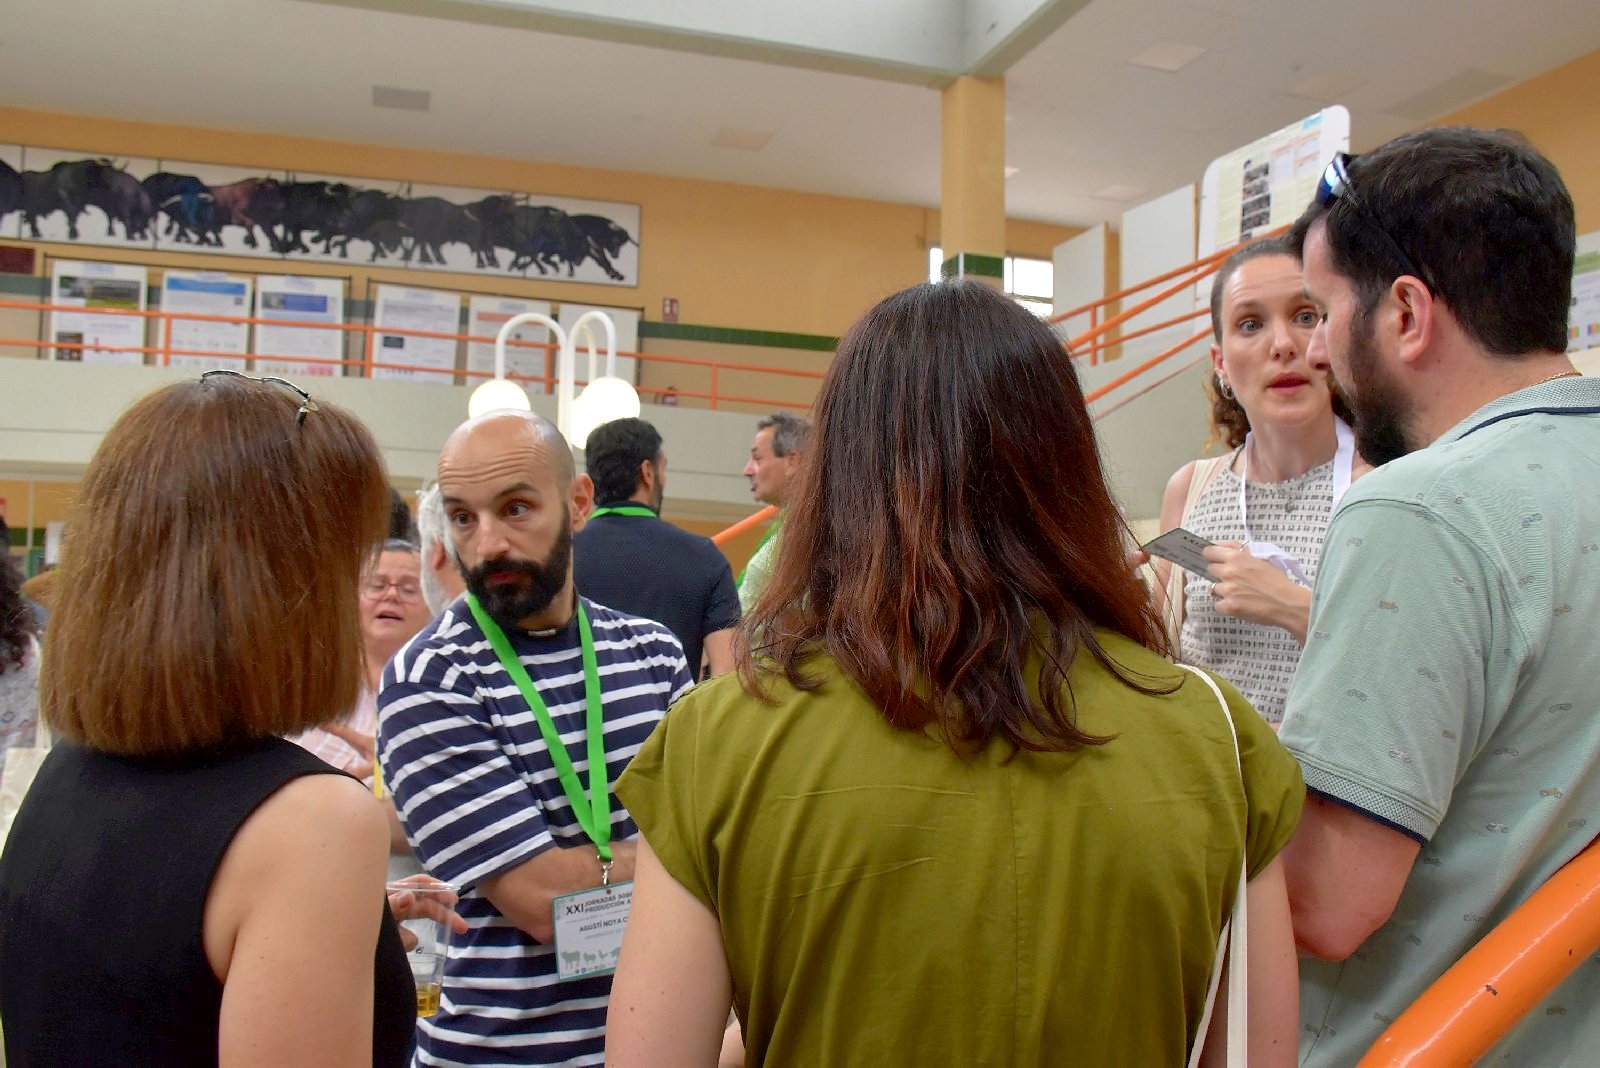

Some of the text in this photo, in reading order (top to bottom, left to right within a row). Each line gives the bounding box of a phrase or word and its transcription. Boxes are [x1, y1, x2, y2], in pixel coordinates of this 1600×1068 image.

[585, 895, 616, 905] JORNADAS
[585, 900, 625, 912] PRODUCCIÓN
[566, 903, 584, 915] XXI
[580, 921, 602, 931] AGUSTÍ
[603, 918, 622, 927] NOTA
